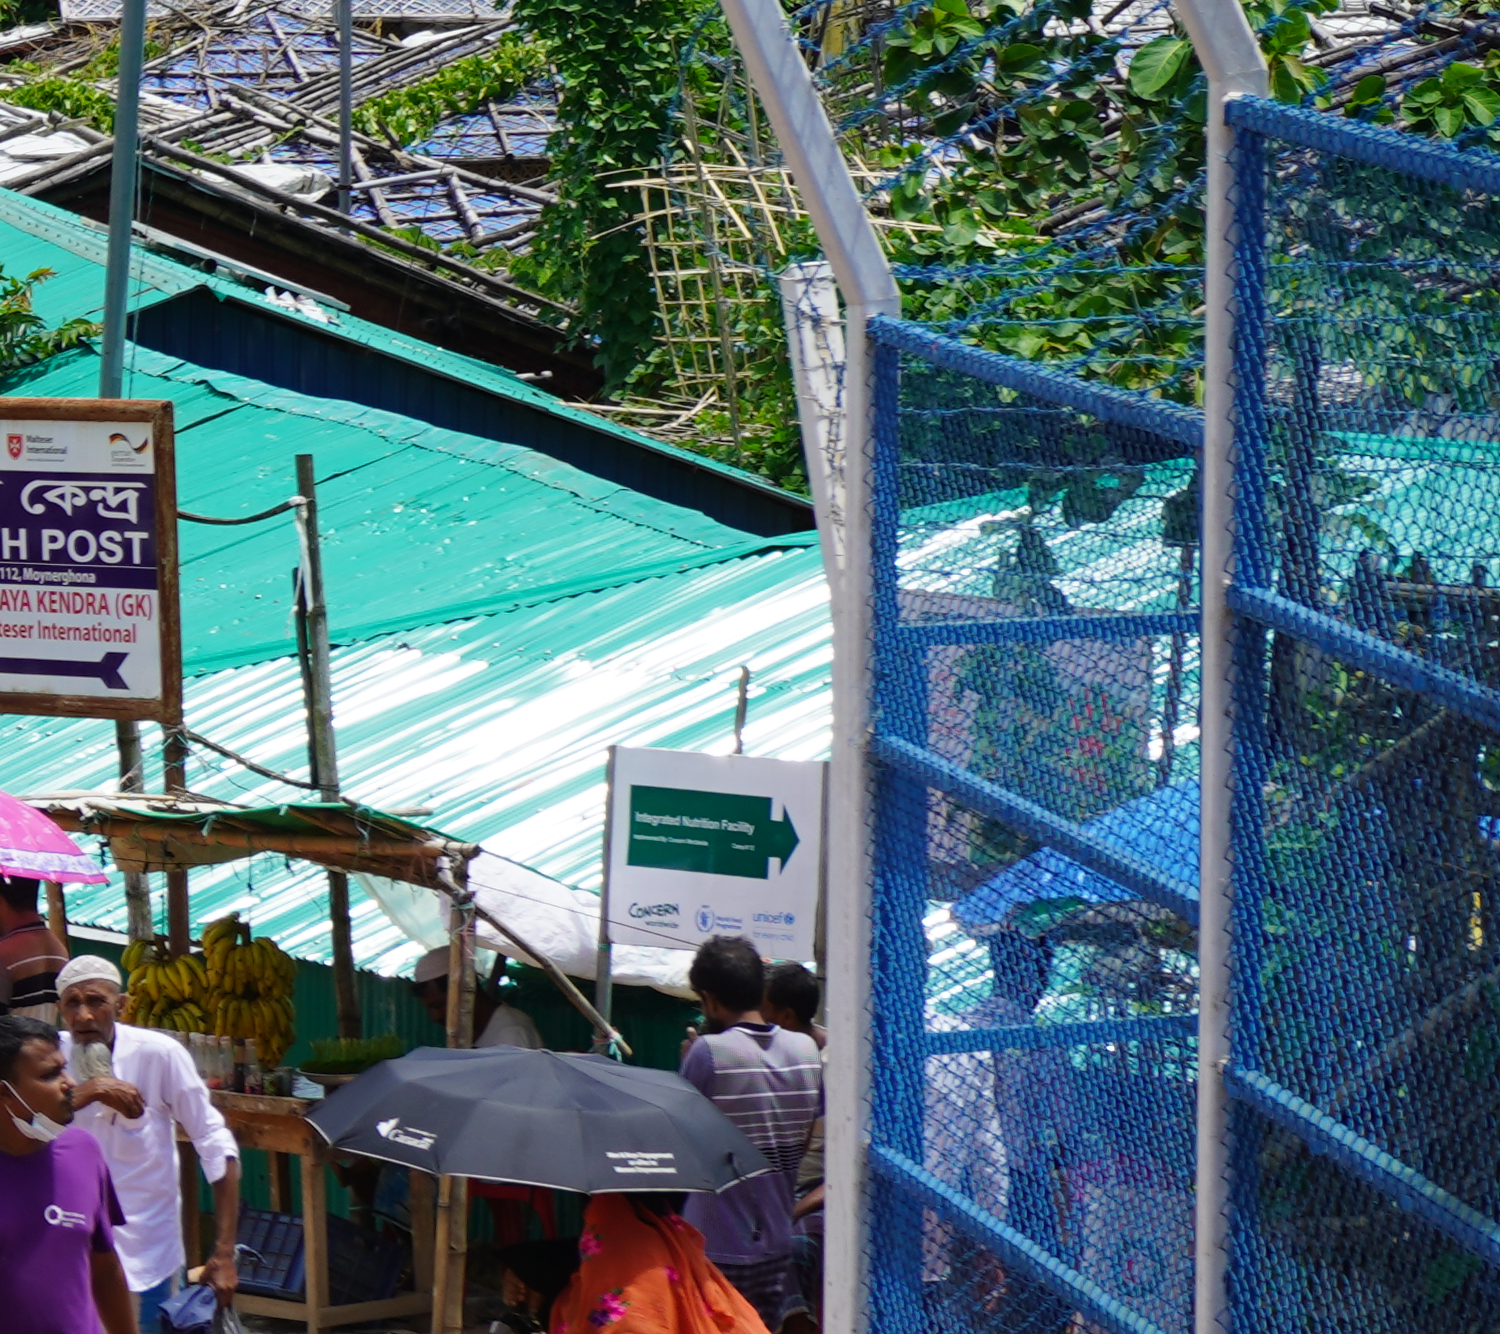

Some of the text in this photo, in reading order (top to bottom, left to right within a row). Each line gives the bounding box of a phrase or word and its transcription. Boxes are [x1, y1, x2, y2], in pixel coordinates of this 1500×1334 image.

[20, 480, 147, 524] কেন্দ্র
[41, 528, 149, 564] POST
[23, 568, 96, 585] Moynerghona
[37, 590, 109, 615] KENDRA
[115, 593, 152, 621] (GK)
[37, 620, 137, 643] International
[634, 811, 755, 836] Integrated Nutrition Facility
[753, 912, 783, 924] unicef
